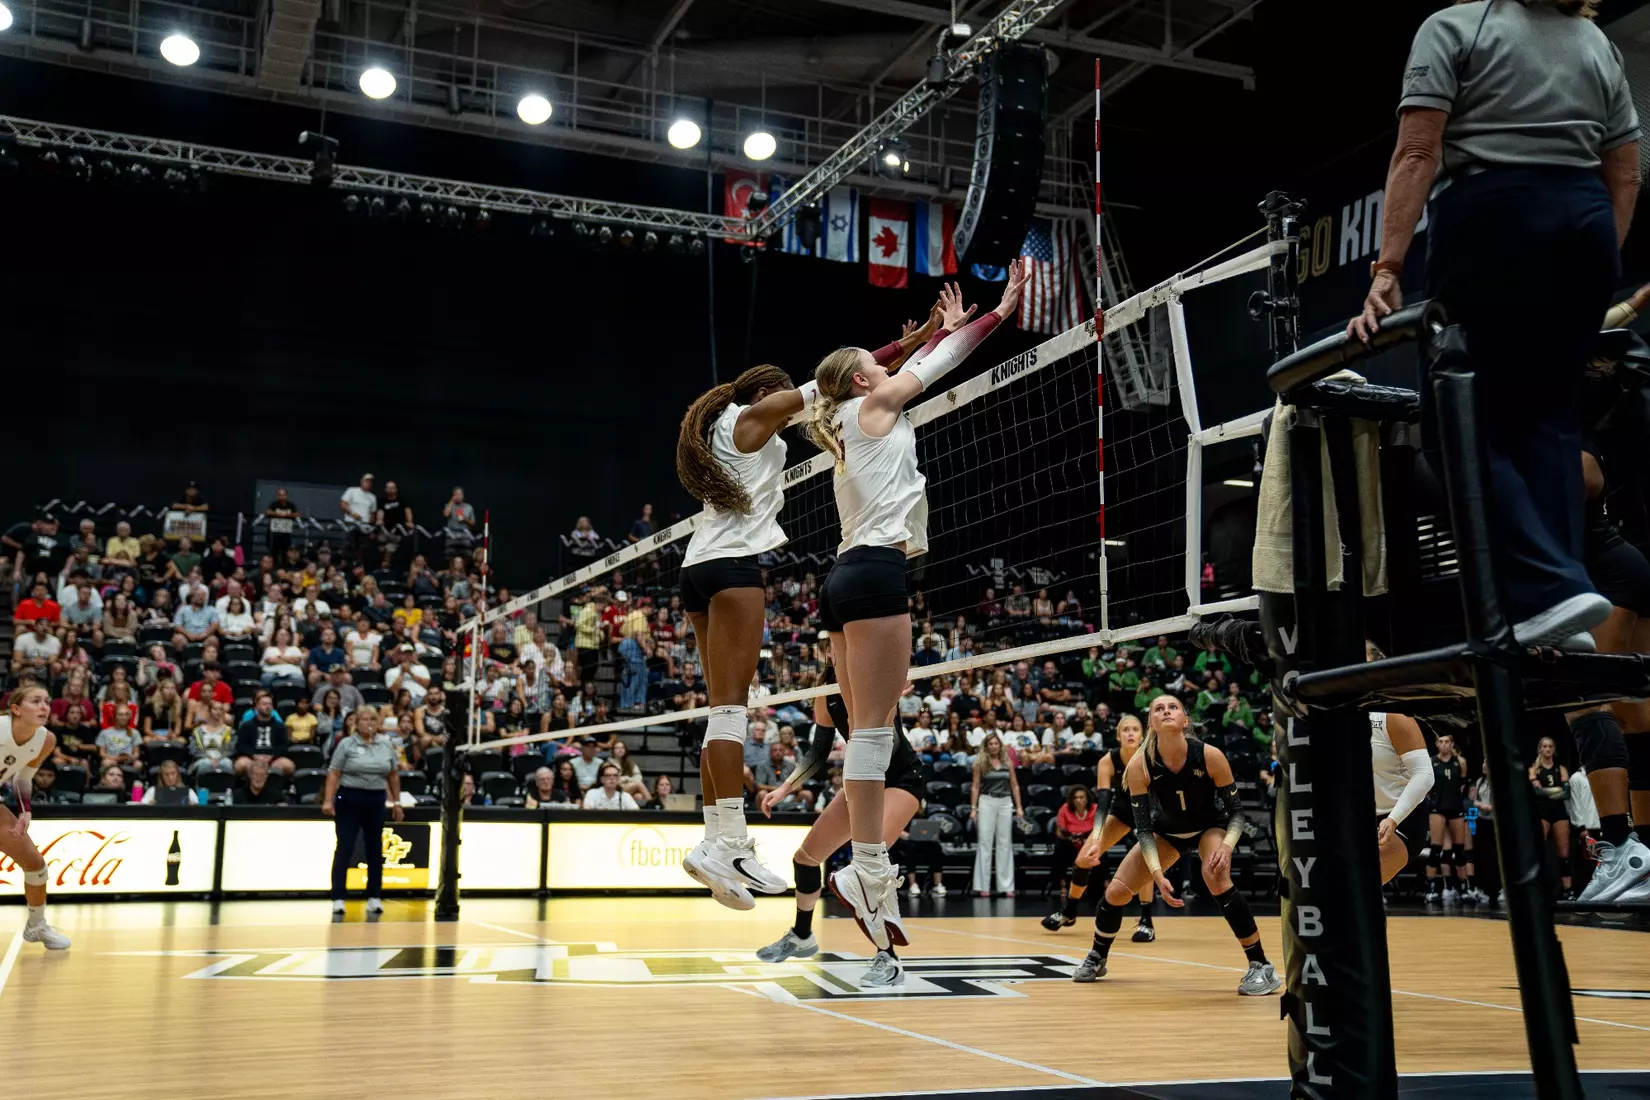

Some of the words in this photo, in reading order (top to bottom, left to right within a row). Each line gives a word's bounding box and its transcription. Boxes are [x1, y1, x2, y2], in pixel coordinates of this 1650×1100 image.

[991, 348, 1038, 386] KNIGHTS
[784, 460, 812, 485] KNIGHTS
[1444, 768, 1452, 780] 4
[1175, 790, 1187, 811] 1
[630, 839, 661, 867] fbc
